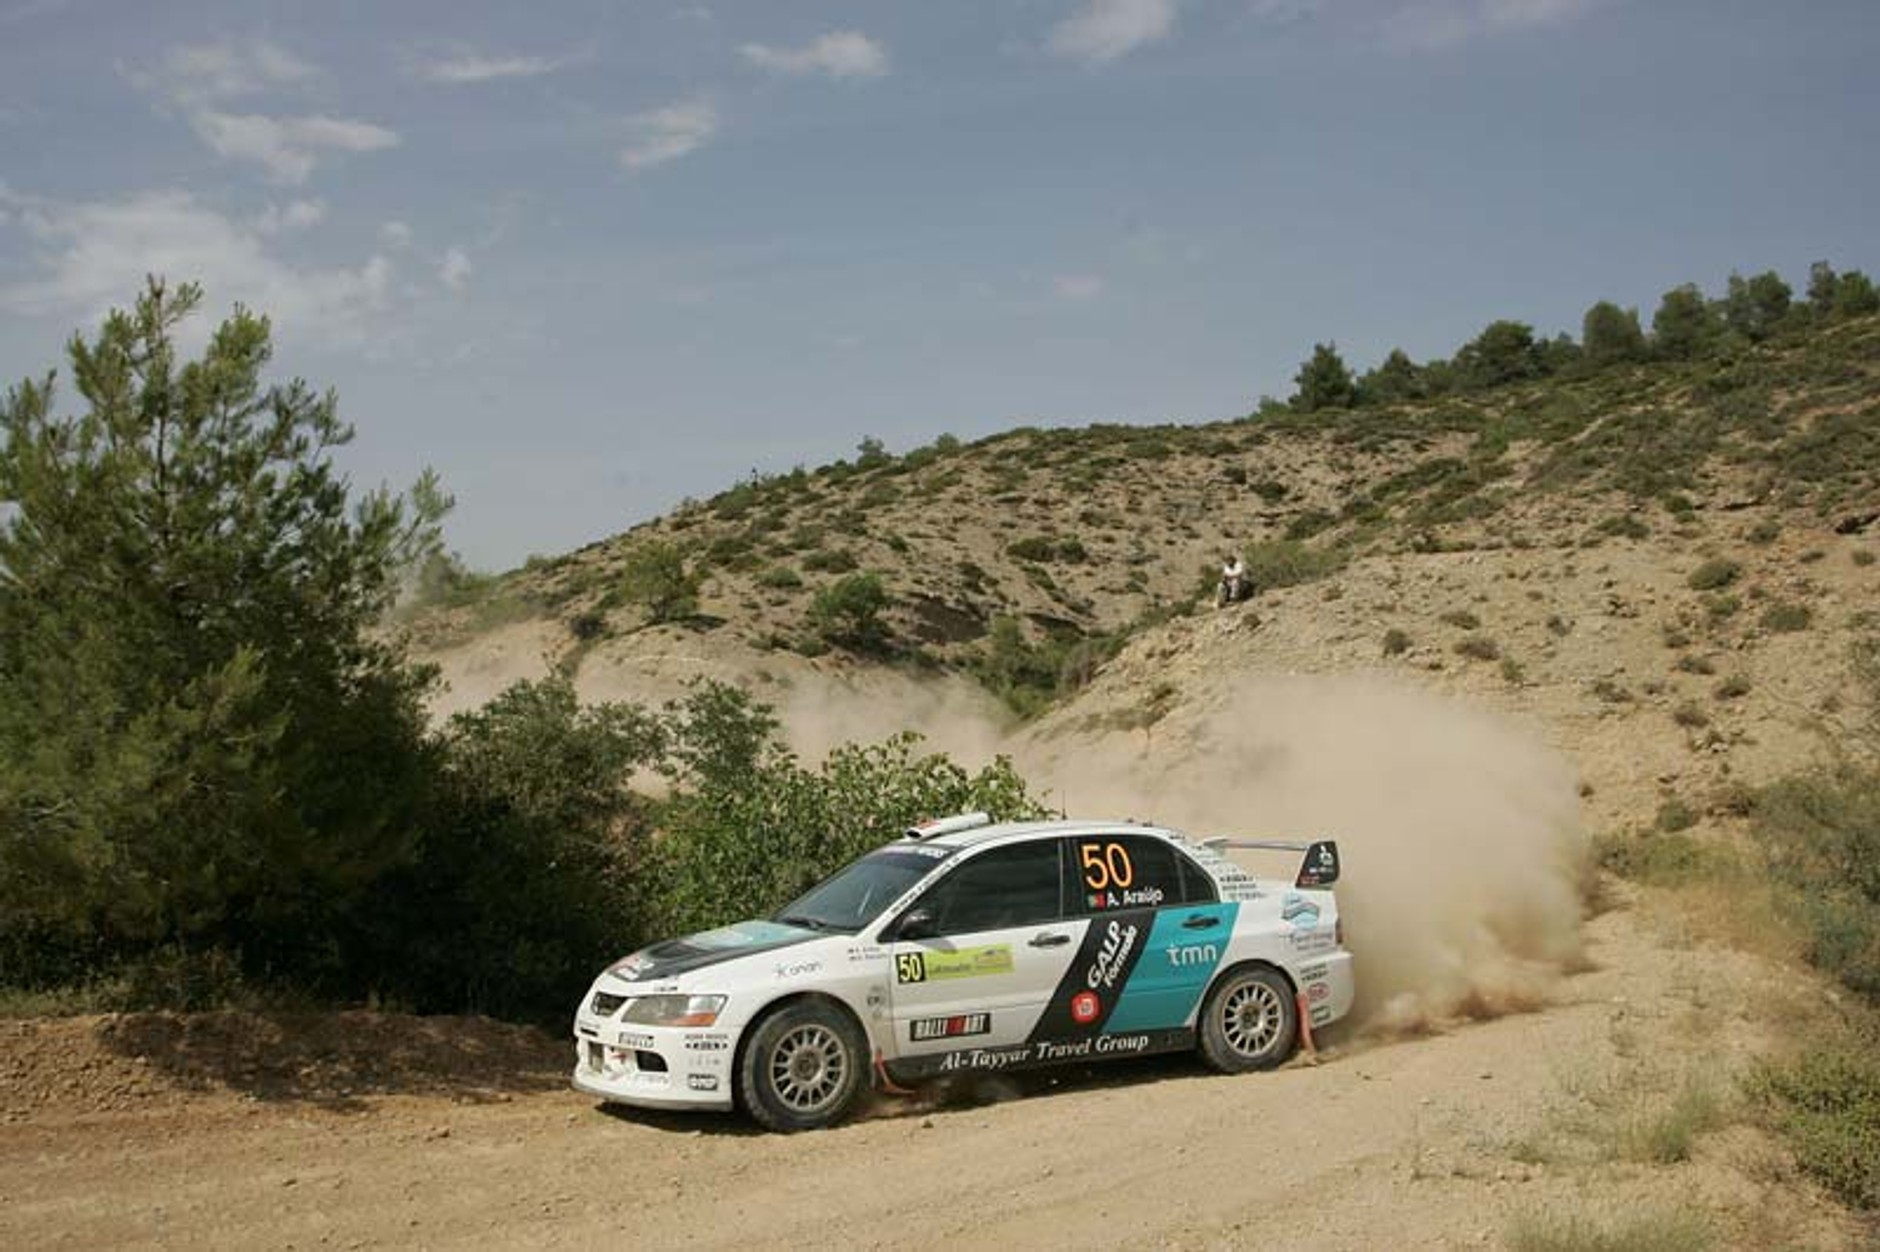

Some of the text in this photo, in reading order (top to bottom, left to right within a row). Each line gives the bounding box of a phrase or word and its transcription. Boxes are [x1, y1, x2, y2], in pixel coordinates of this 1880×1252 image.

[1081, 843, 1133, 889] 50
[1106, 891, 1120, 907] A.
[898, 955, 922, 982] 50
[1086, 920, 1121, 988] GALP
[1165, 943, 1218, 967] tmn
[939, 1034, 1149, 1072] Al-Tayyar Travel Group
